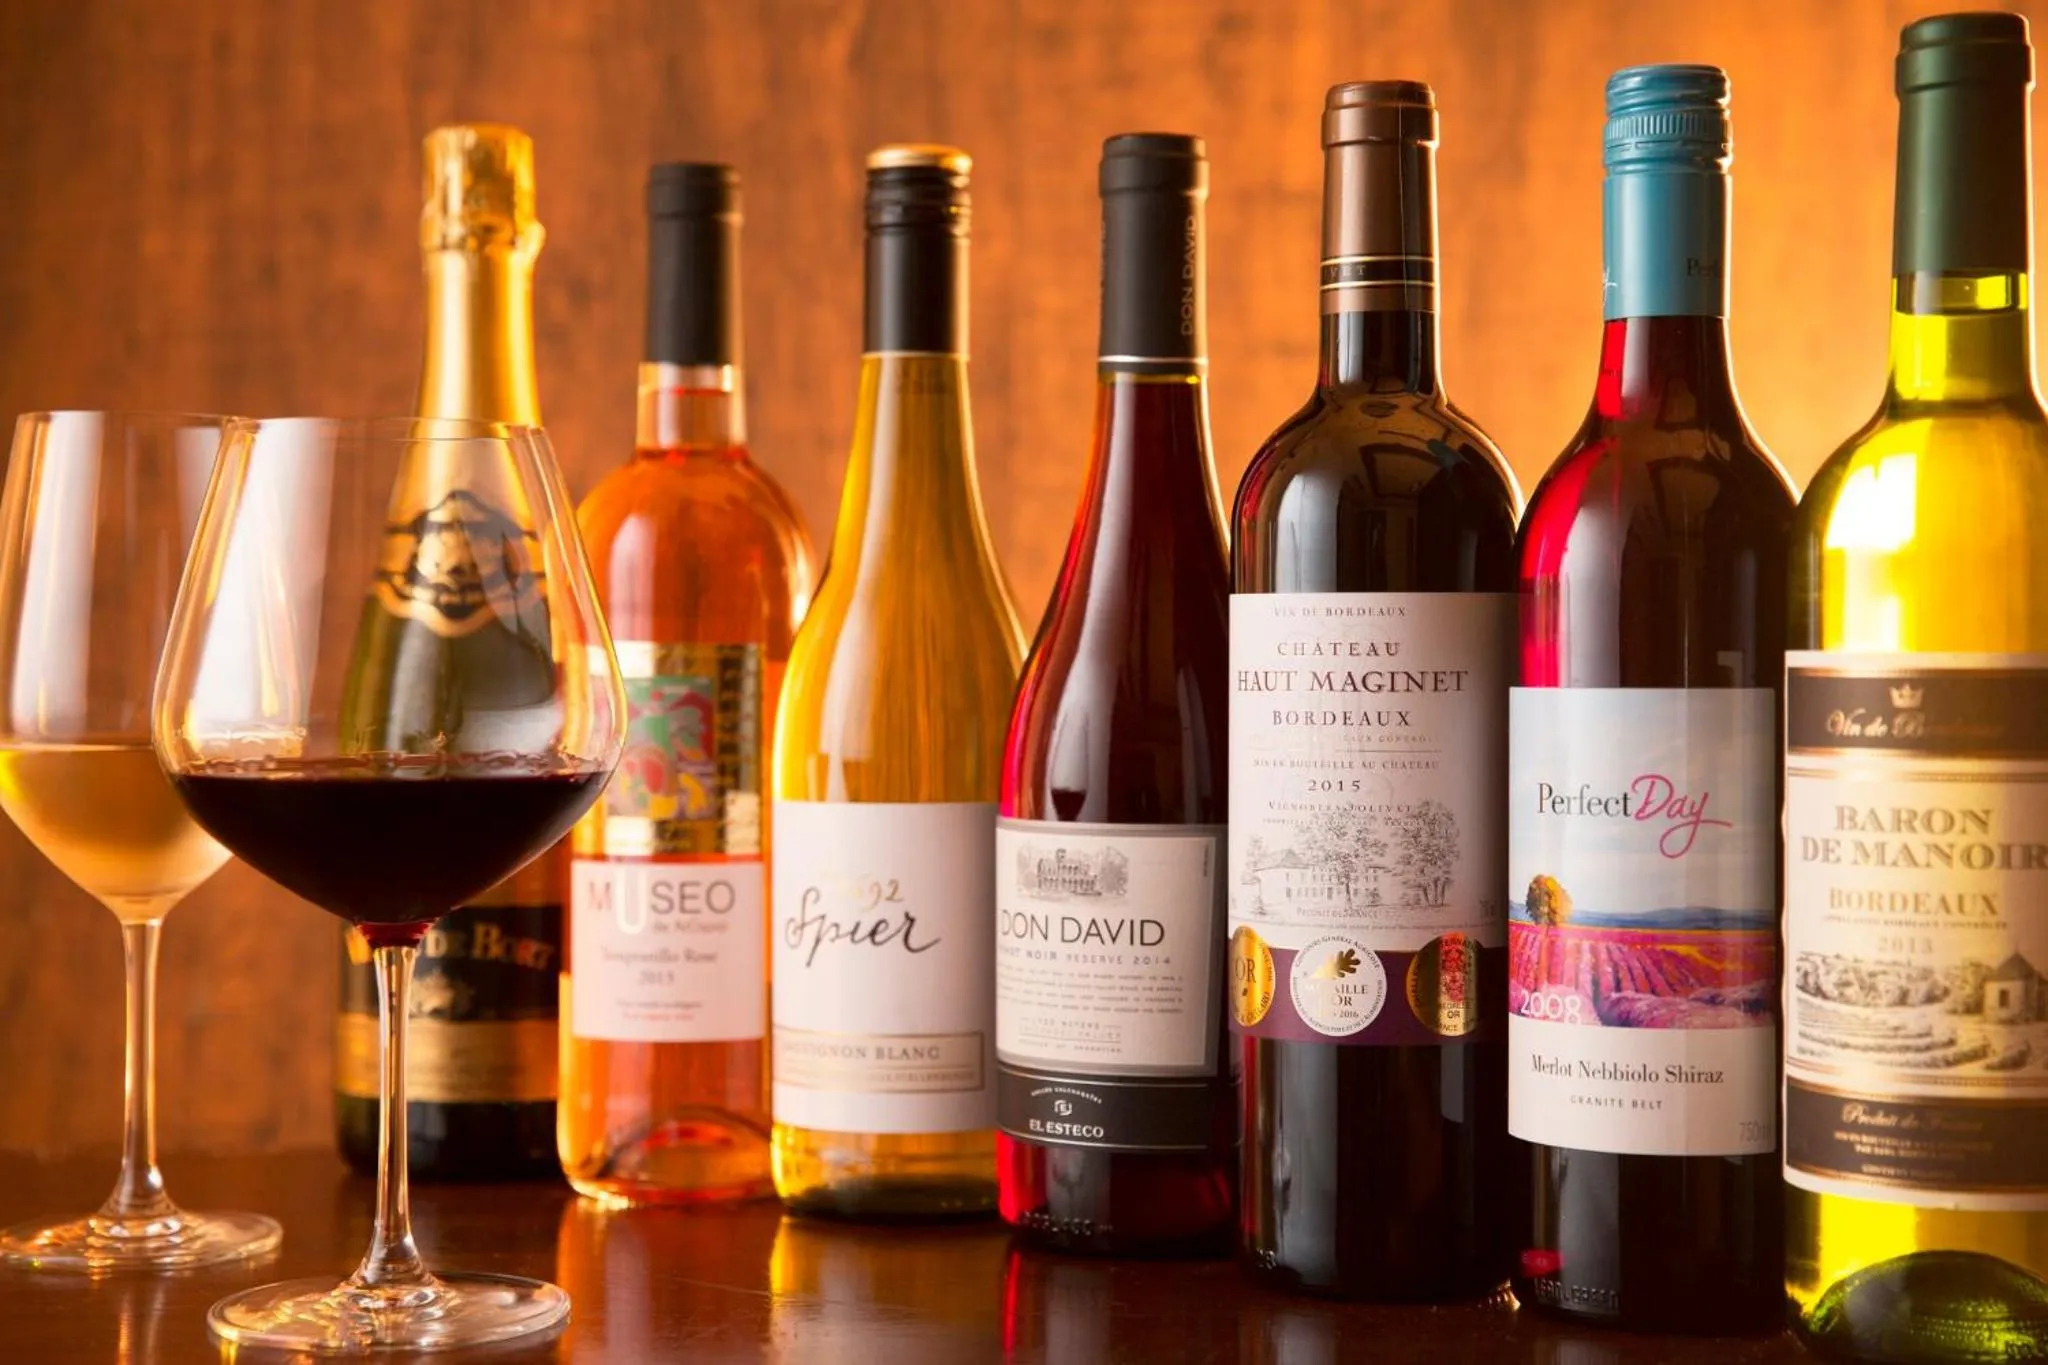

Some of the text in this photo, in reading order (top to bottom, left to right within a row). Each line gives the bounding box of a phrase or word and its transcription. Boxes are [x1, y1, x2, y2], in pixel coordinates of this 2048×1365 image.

[1181, 216, 1196, 336] DON DAVID
[1326, 607, 1406, 617] BORDEAUX
[1238, 670, 1469, 692] HAUT MAGINET
[1273, 710, 1414, 727] BORDEAUX
[1307, 780, 1362, 793] 2015
[1537, 774, 1733, 859] Perfect Day
[1834, 805, 1994, 834] BARON
[1801, 836, 2048, 870] DE MANOIR
[588, 866, 736, 934] MUSEO
[1830, 887, 1999, 916] BORDEAUX
[785, 886, 942, 968] Spier
[1000, 909, 1165, 946] DON DAVID
[1026, 949, 1057, 961] NOIR
[1066, 953, 1122, 964] RESERVE
[1133, 955, 1171, 965] 2014
[1521, 990, 1581, 1025] 2008
[876, 1046, 940, 1060] BLANC
[1531, 1054, 1724, 1084] Merlot Nebbiolo Shiraz
[1571, 1095, 1663, 1110] GRANITE BELT
[1029, 1118, 1104, 1138] EL ESTECO
